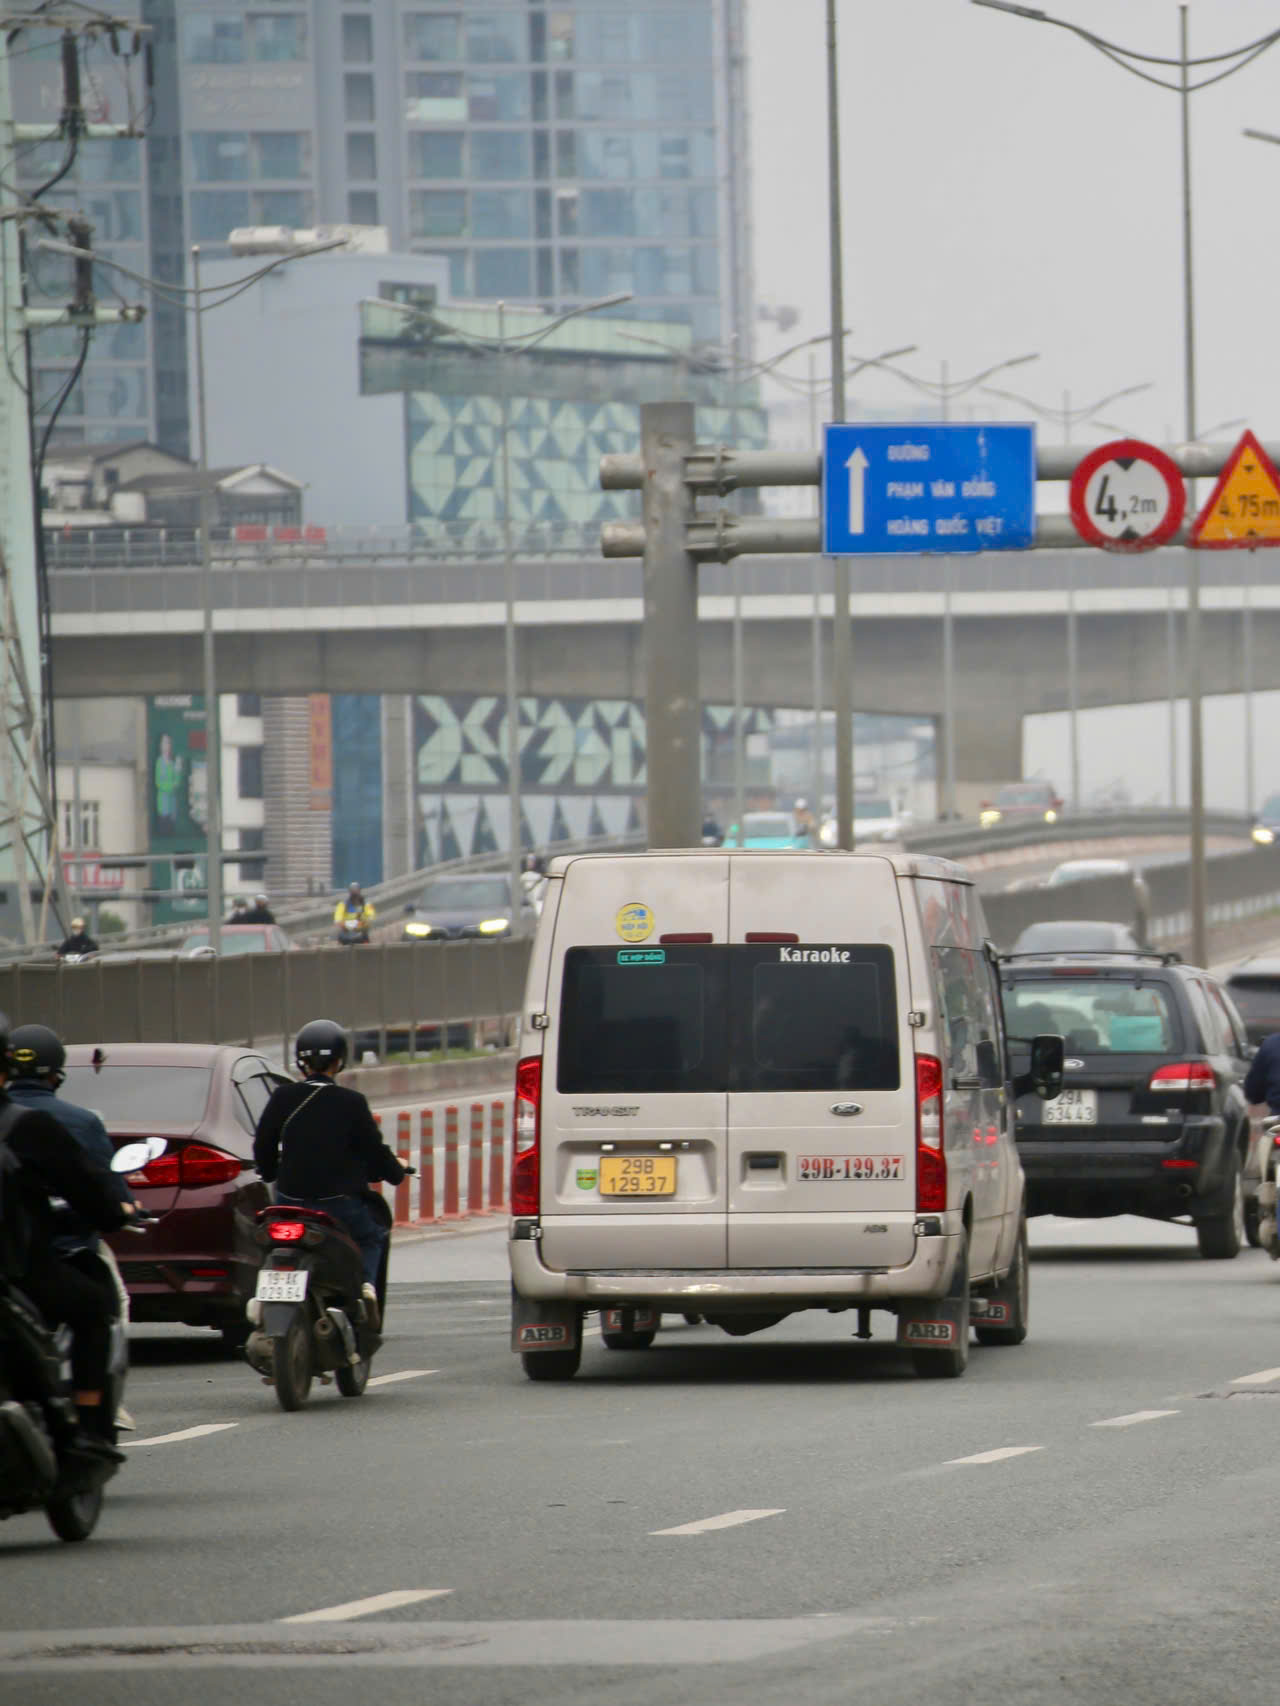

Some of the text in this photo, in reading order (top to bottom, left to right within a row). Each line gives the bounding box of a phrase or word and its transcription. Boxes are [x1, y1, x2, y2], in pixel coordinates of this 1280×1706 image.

[779, 946, 851, 963] Karaoke
[572, 1105, 640, 1117] TRANSIT
[621, 1159, 654, 1175] 29B
[801, 1157, 901, 1179] 29B-129.37
[608, 1176, 667, 1193] 129.37
[522, 1327, 563, 1342] ARB
[908, 1324, 950, 1340] ARB
